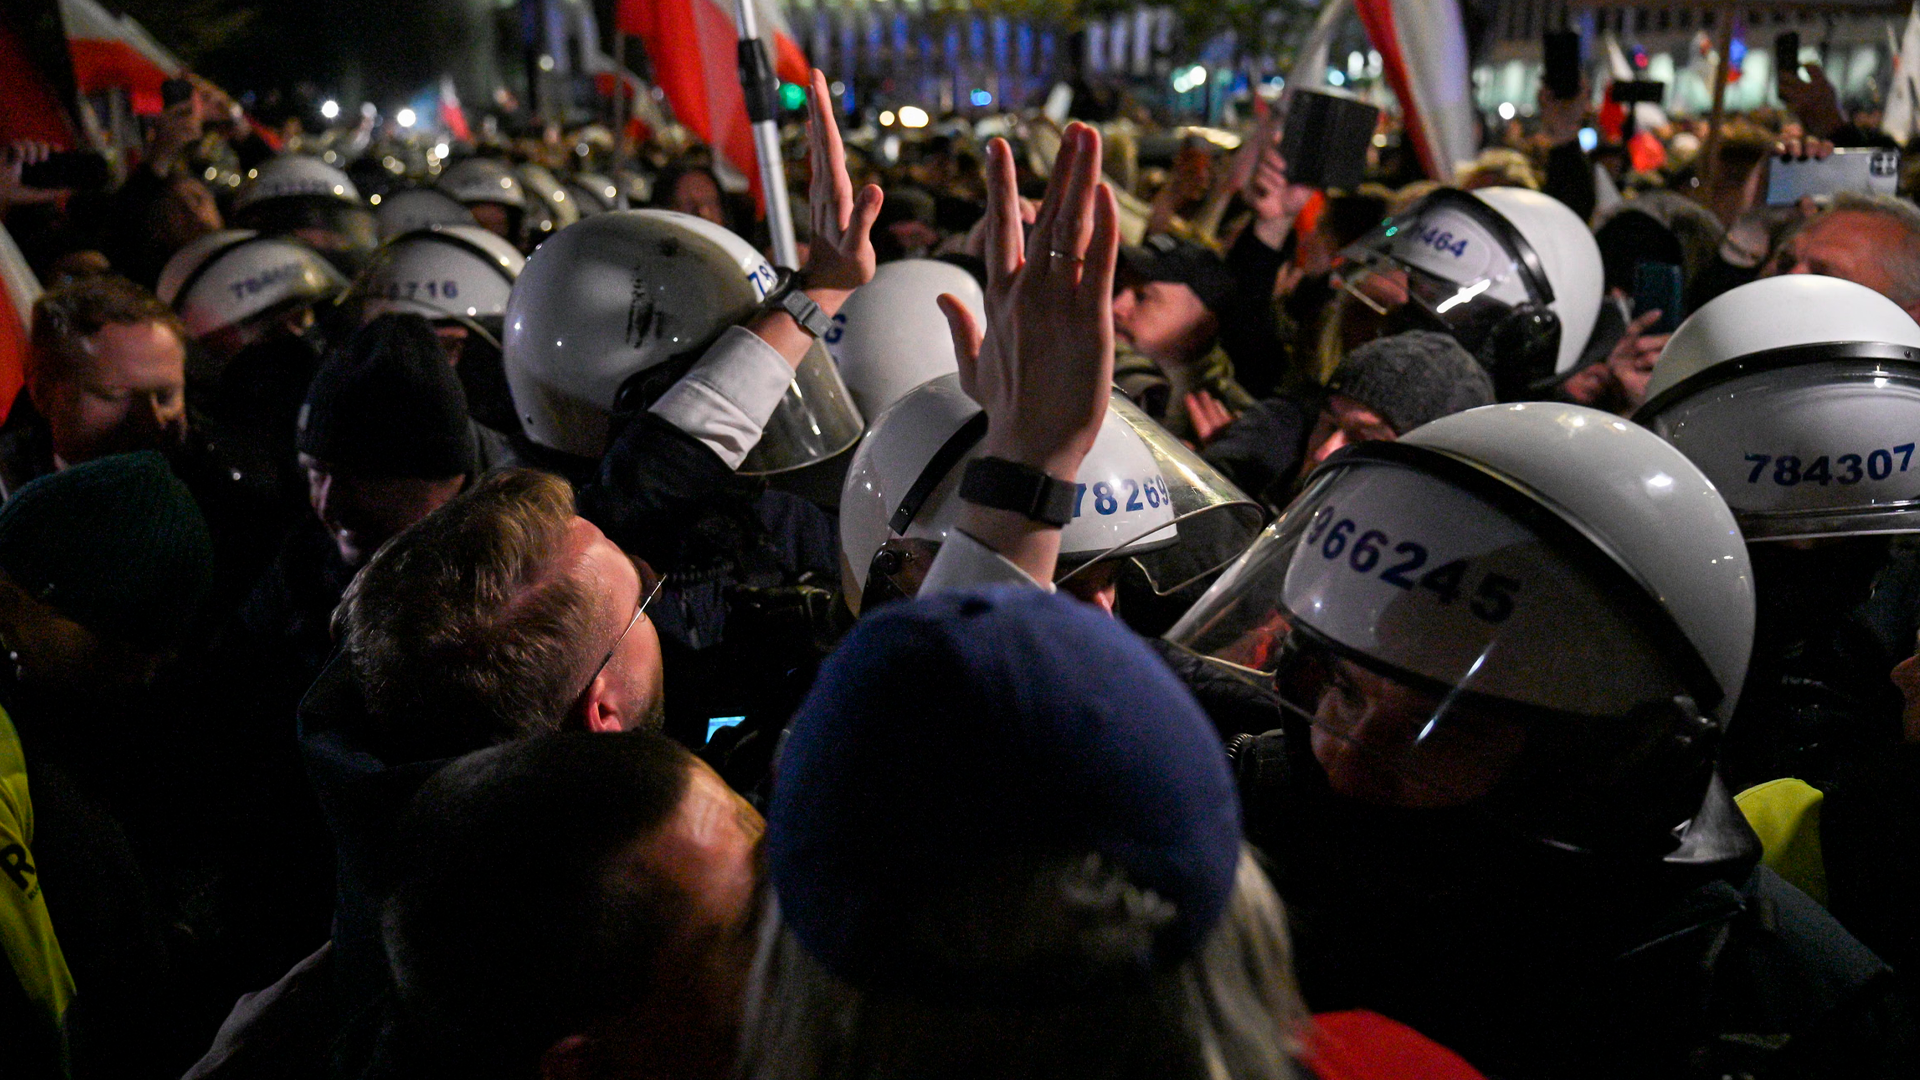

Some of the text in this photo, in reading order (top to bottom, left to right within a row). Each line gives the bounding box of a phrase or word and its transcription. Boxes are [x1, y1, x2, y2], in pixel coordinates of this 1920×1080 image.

[1419, 224, 1468, 257] 464
[1744, 442, 1916, 487] 784307
[1072, 474, 1170, 518] 78269
[1307, 505, 1523, 623] 966245
